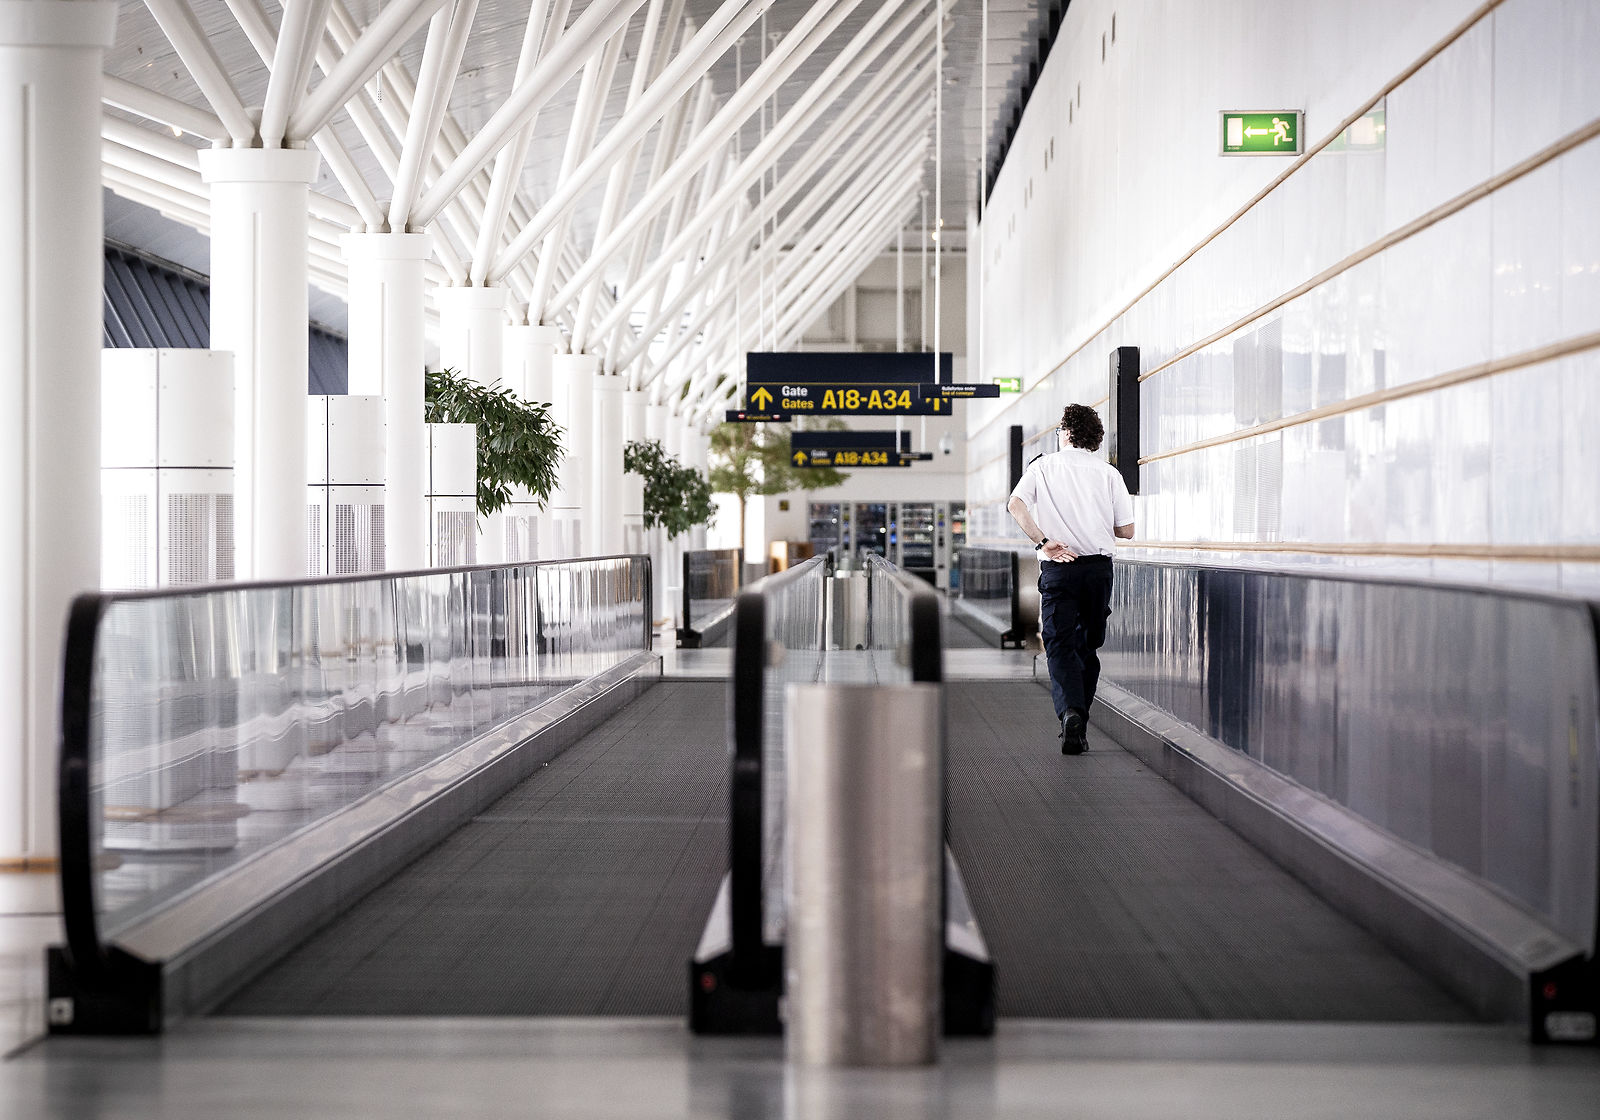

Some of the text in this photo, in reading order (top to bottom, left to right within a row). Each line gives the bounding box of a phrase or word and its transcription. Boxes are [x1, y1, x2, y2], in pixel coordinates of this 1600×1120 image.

[781, 385, 808, 396] Gate
[781, 398, 814, 409] Gates
[821, 389, 912, 409] A18-A34
[834, 451, 888, 465] A18-A34
